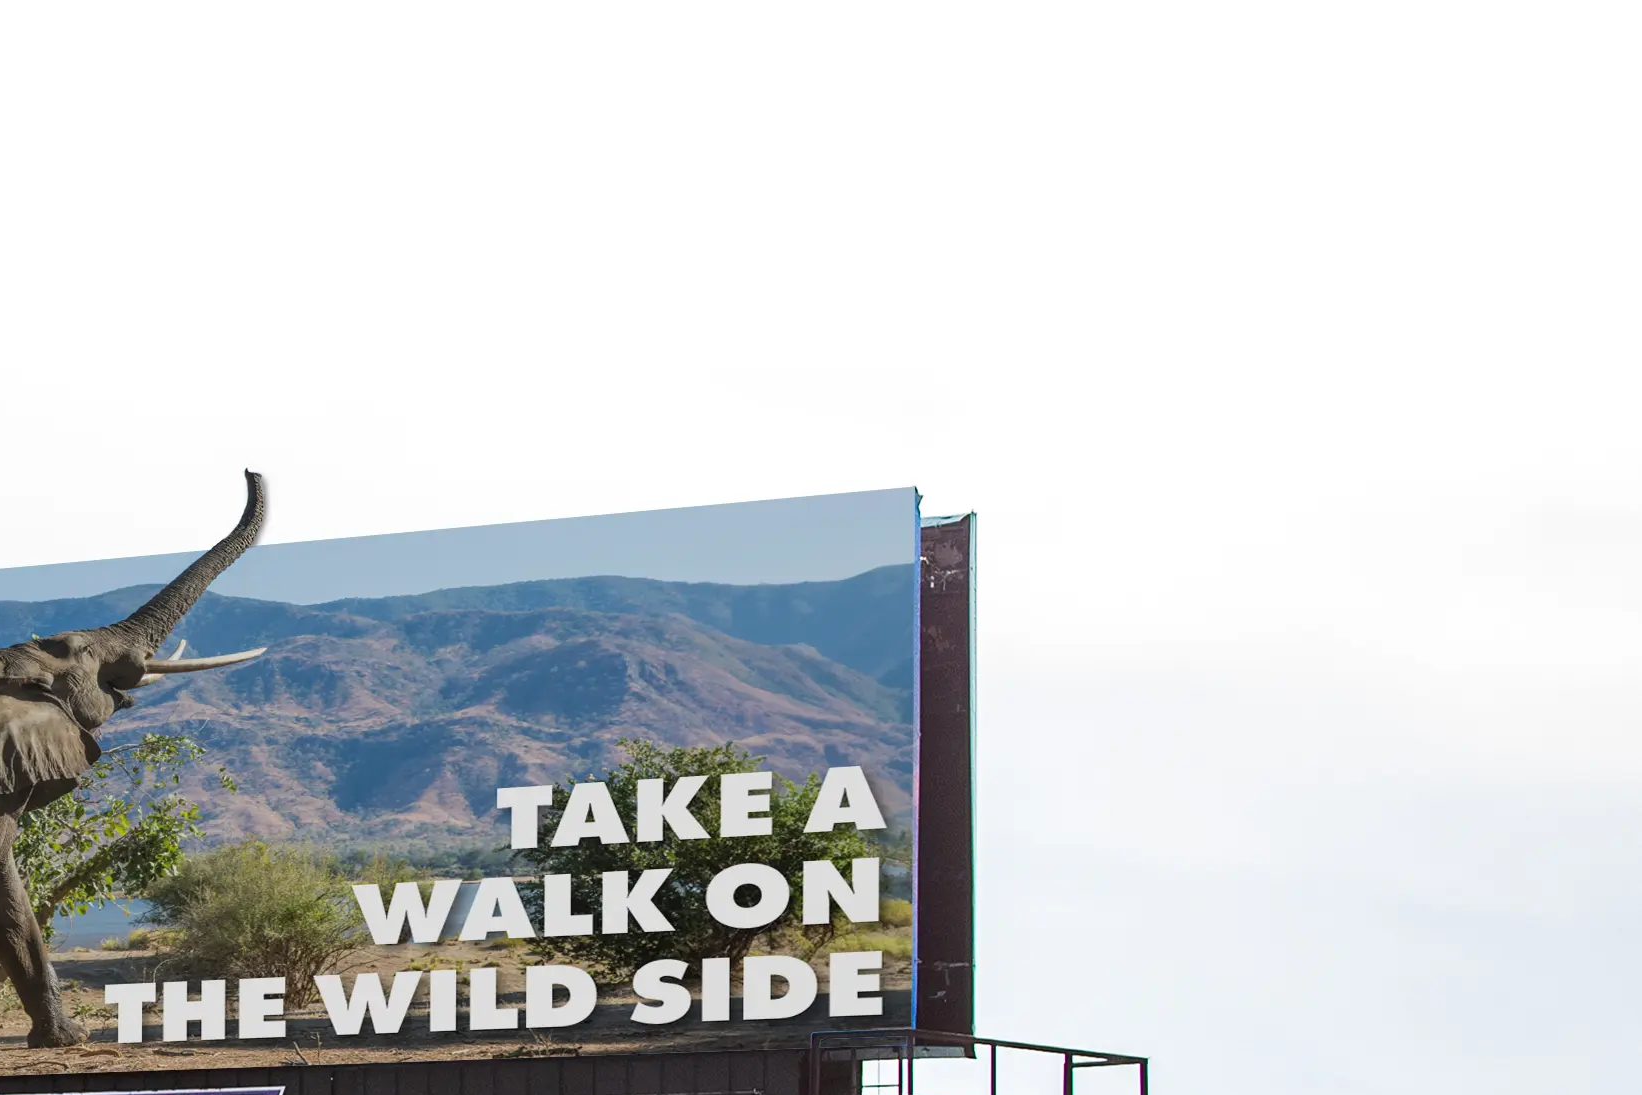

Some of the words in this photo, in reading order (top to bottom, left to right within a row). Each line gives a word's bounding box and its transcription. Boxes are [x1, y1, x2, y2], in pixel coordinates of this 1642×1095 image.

[496, 770, 774, 851] TAKE
[803, 765, 888, 833] A
[352, 867, 676, 946] WALK
[705, 857, 881, 930] ON
[104, 975, 287, 1045] THE
[312, 964, 598, 1037] WILD
[629, 950, 884, 1026] SIDE
